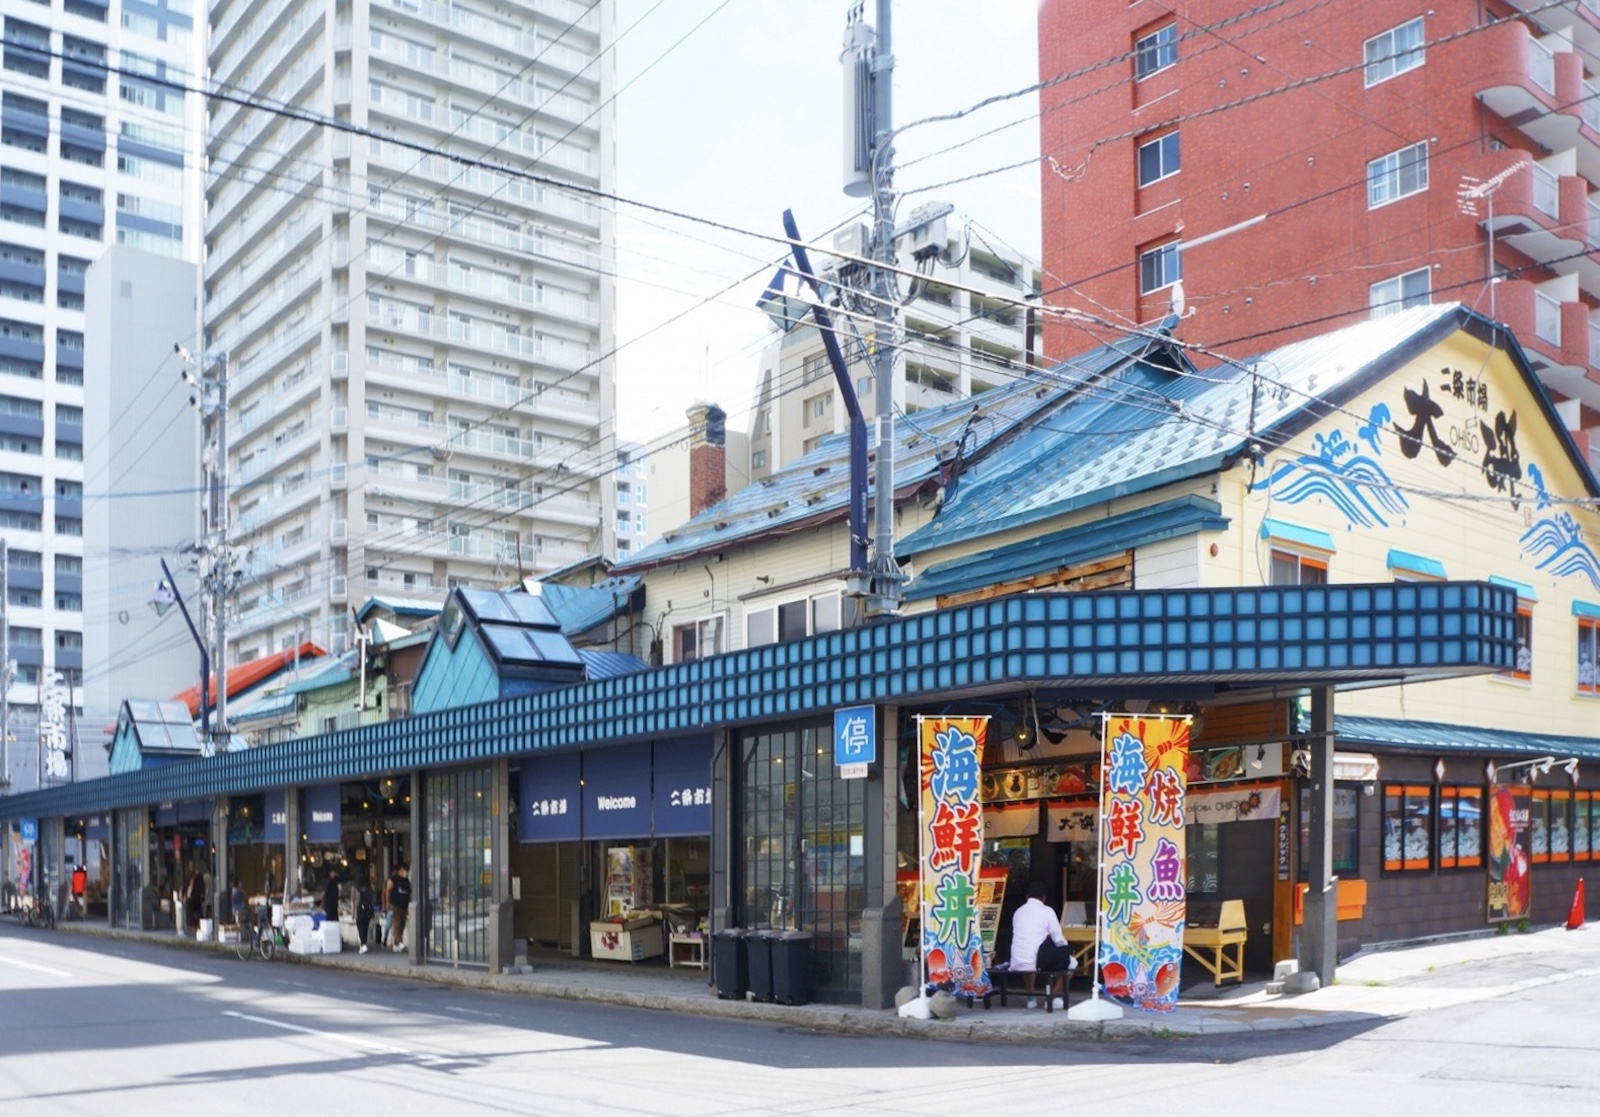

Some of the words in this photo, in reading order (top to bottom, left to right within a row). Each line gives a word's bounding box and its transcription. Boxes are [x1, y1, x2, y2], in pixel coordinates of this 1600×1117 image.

[1440, 367, 1488, 412] 二条市場
[1450, 425, 1480, 454] OHISO
[840, 716, 869, 755] 停
[532, 798, 568, 816] 二条市場
[597, 796, 636, 811] Welcome
[930, 726, 982, 949] 海鮮丼
[1106, 733, 1147, 926] 海鮮丼
[1149, 769, 1186, 901] 焼魚
